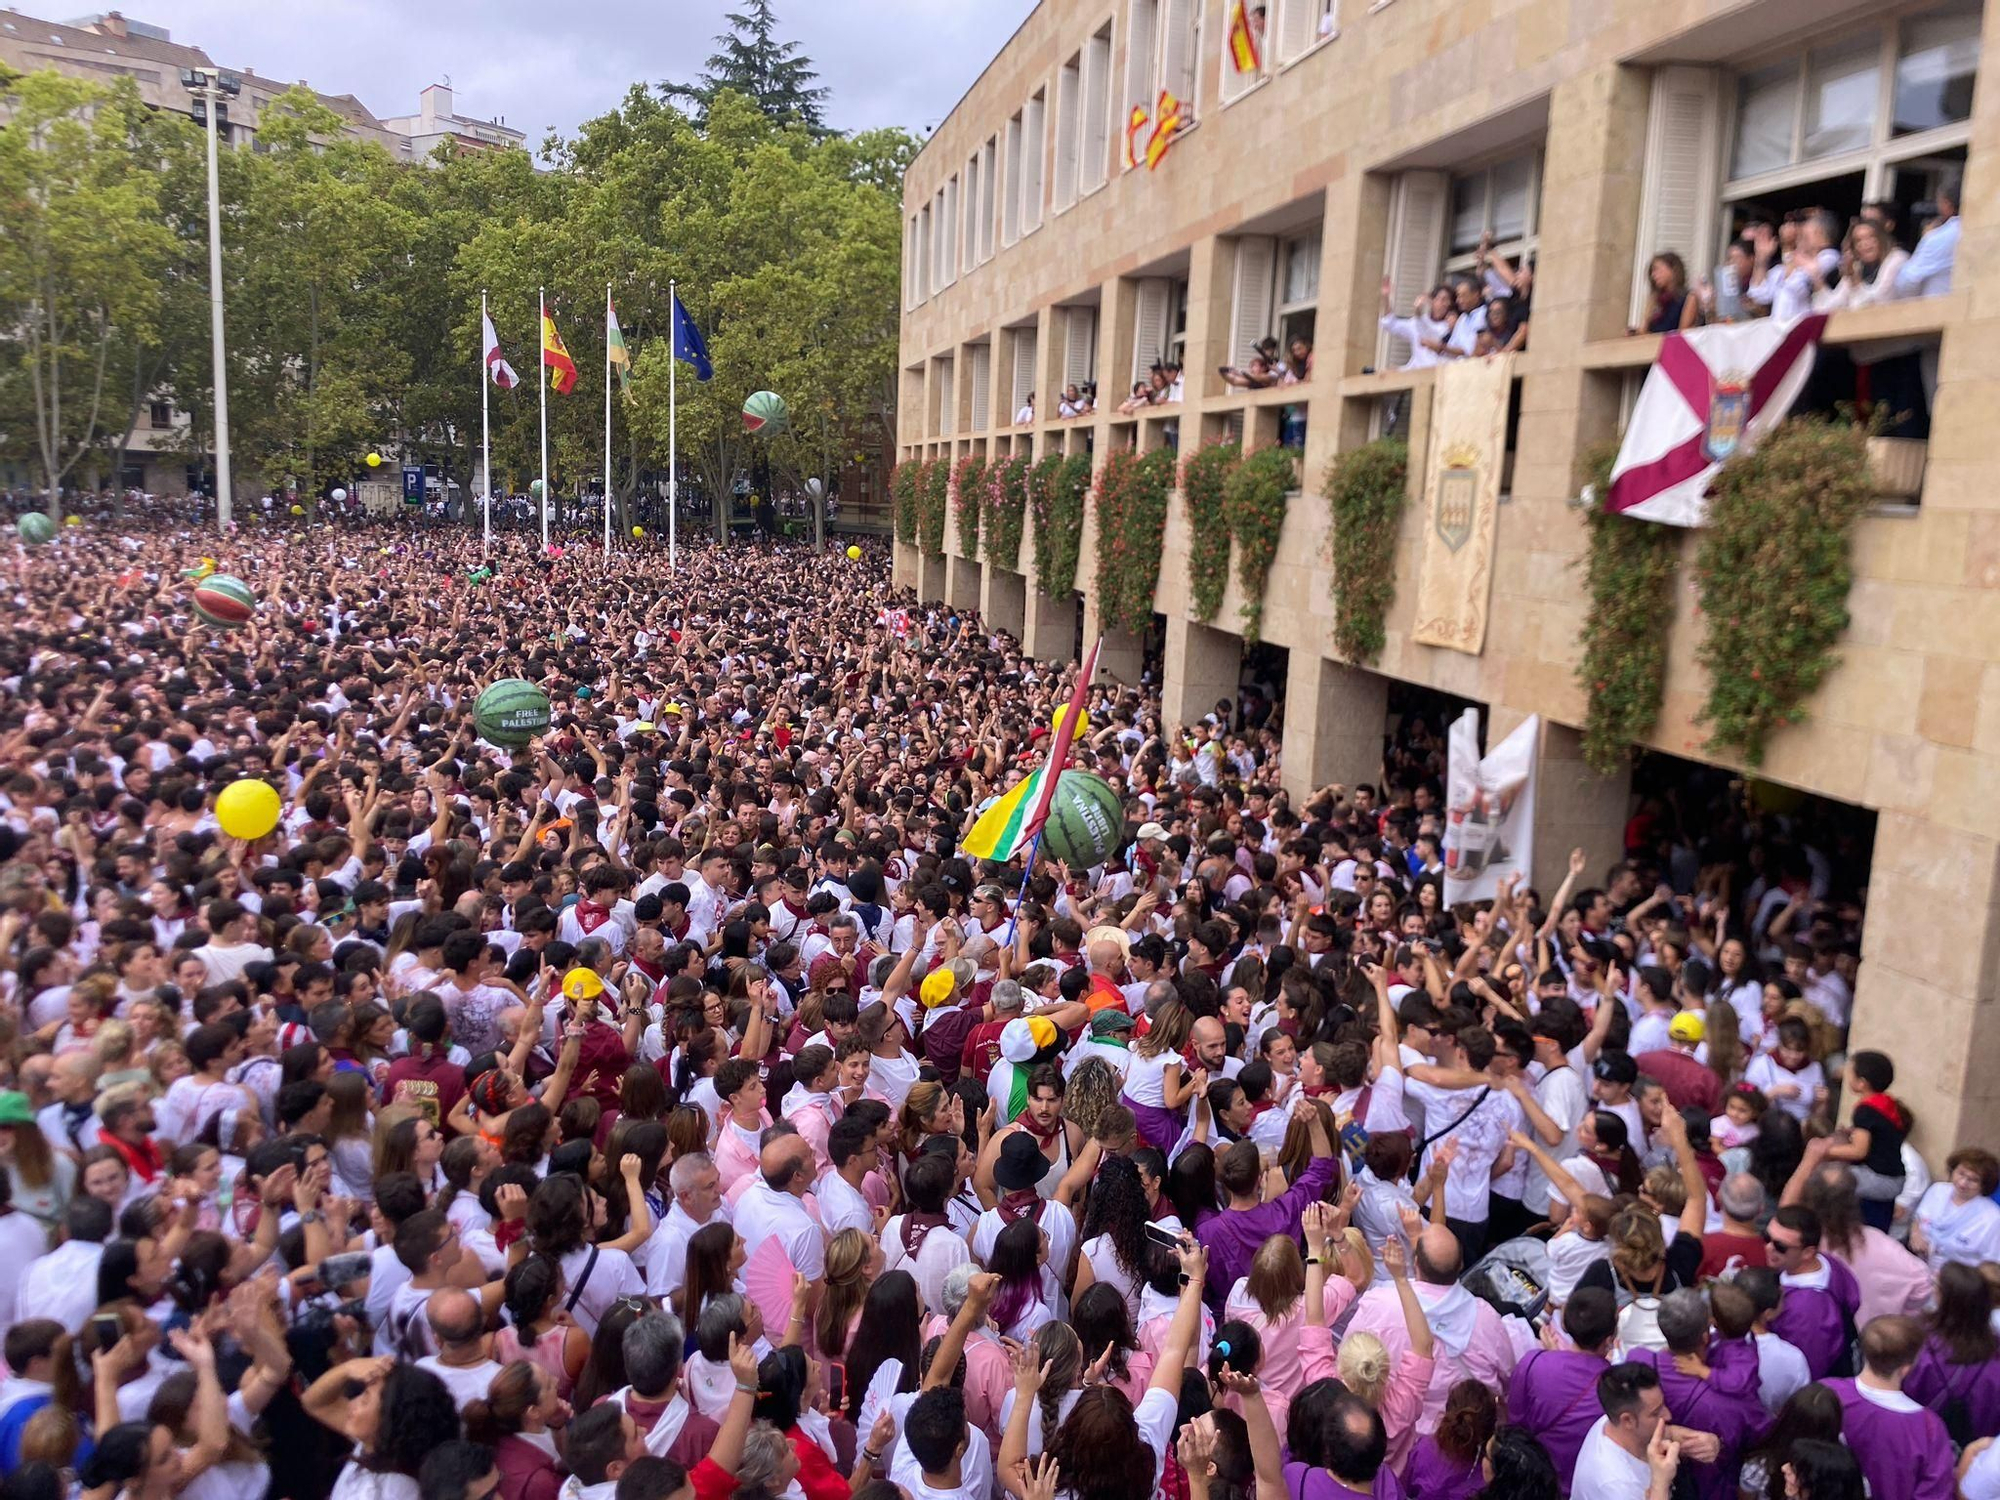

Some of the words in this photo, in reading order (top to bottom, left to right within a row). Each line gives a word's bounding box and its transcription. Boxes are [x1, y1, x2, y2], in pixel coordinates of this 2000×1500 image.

[407, 473, 417, 490] P
[502, 716, 547, 727] PALESTI
[516, 709, 539, 718] FREE
[1073, 794, 1105, 854] PALESTINA
[1089, 801, 1110, 836] LIBRE
